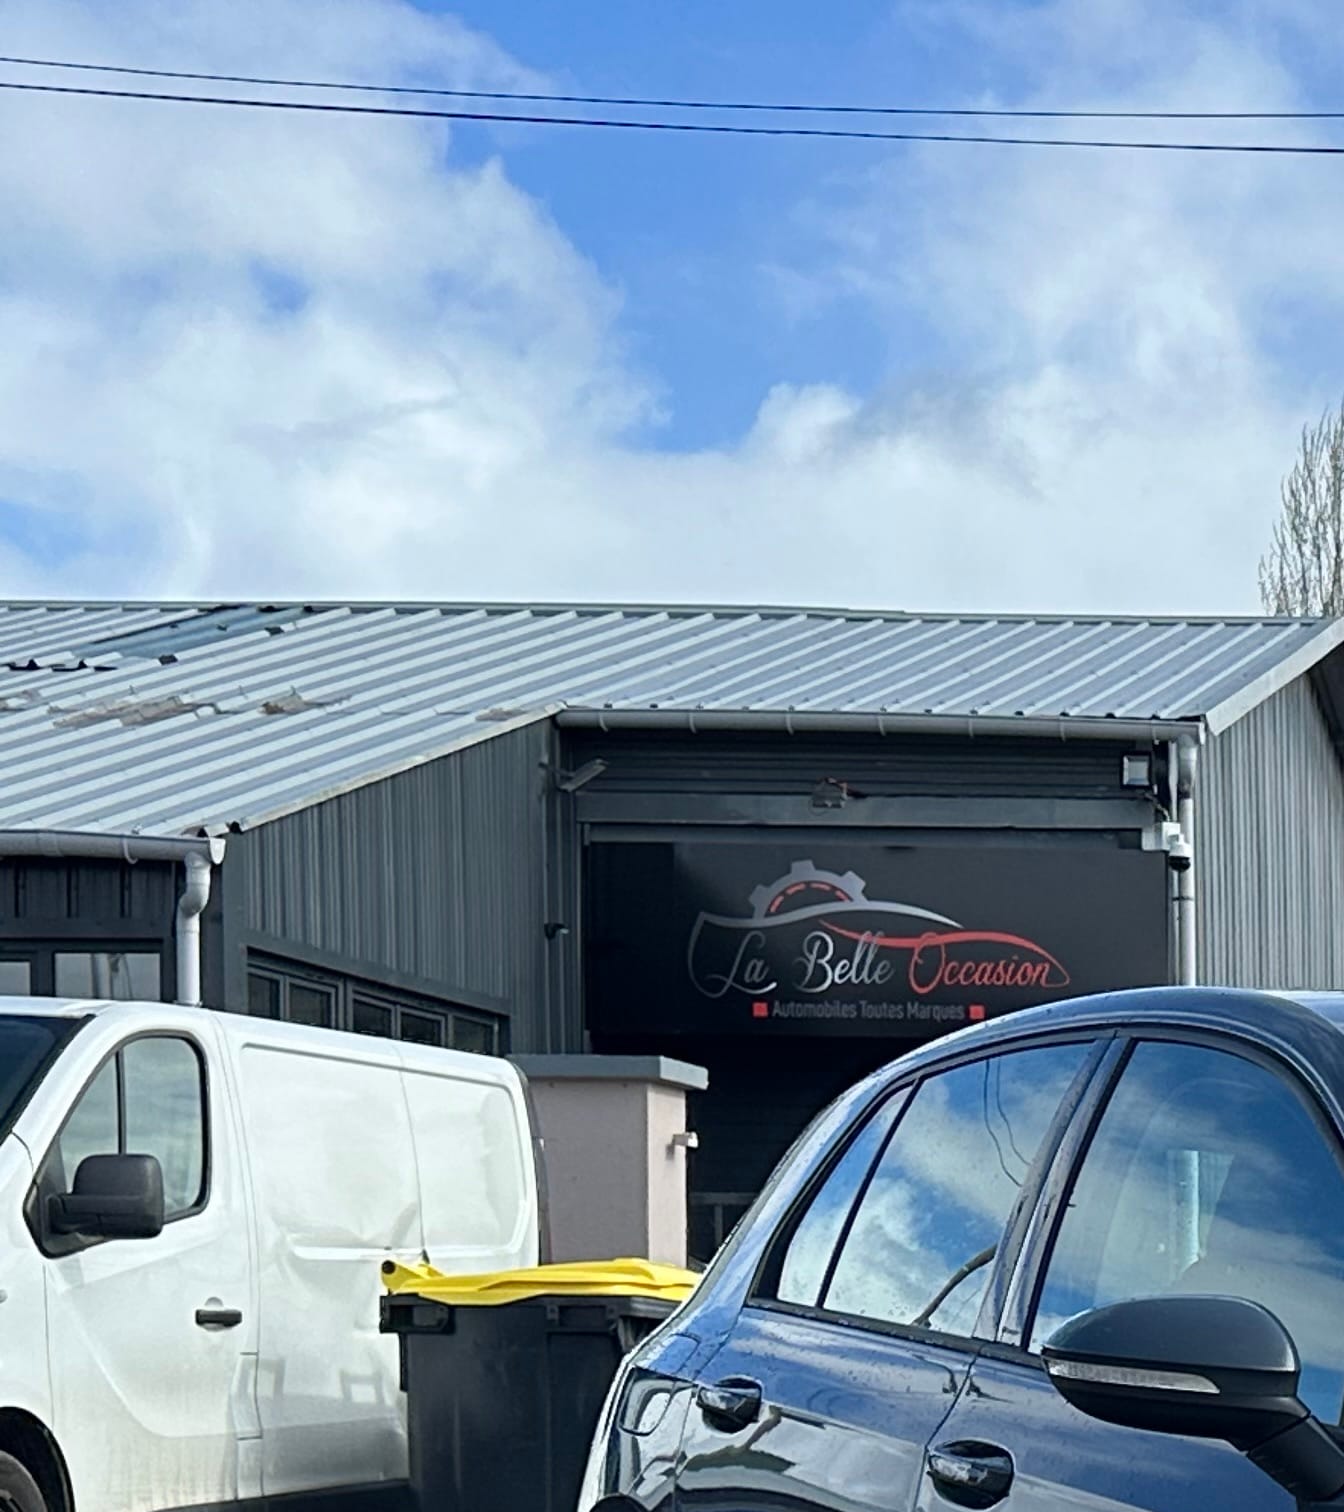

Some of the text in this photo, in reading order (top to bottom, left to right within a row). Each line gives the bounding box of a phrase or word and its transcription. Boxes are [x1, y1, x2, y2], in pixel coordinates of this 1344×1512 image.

[688, 929, 1071, 998] La Belle Occasion
[772, 1001, 965, 1020] Automobiles Toutes Marques
